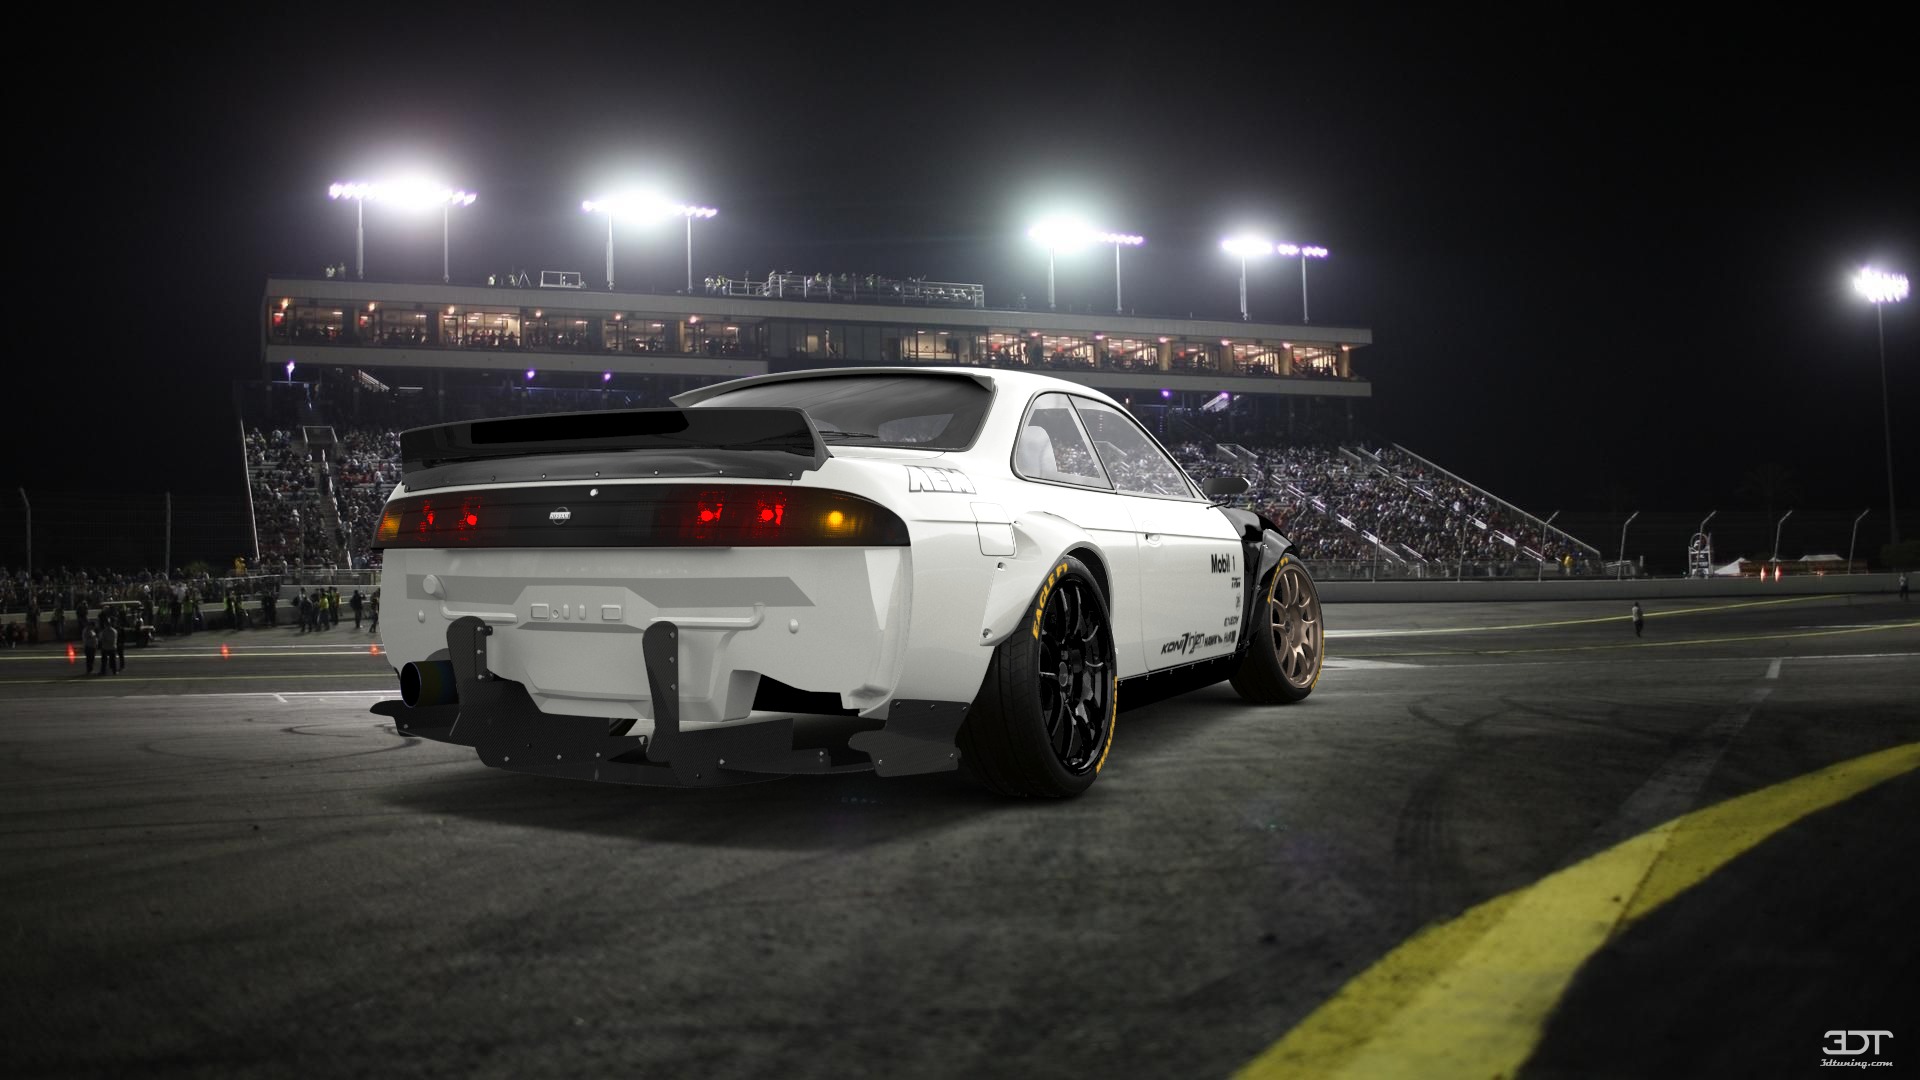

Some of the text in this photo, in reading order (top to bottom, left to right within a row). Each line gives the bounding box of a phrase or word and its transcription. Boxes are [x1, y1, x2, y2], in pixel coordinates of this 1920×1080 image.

[549, 511, 571, 520] NISSAN
[1211, 553, 1230, 573] Mobil
[1033, 563, 1068, 640] EAGLE F1
